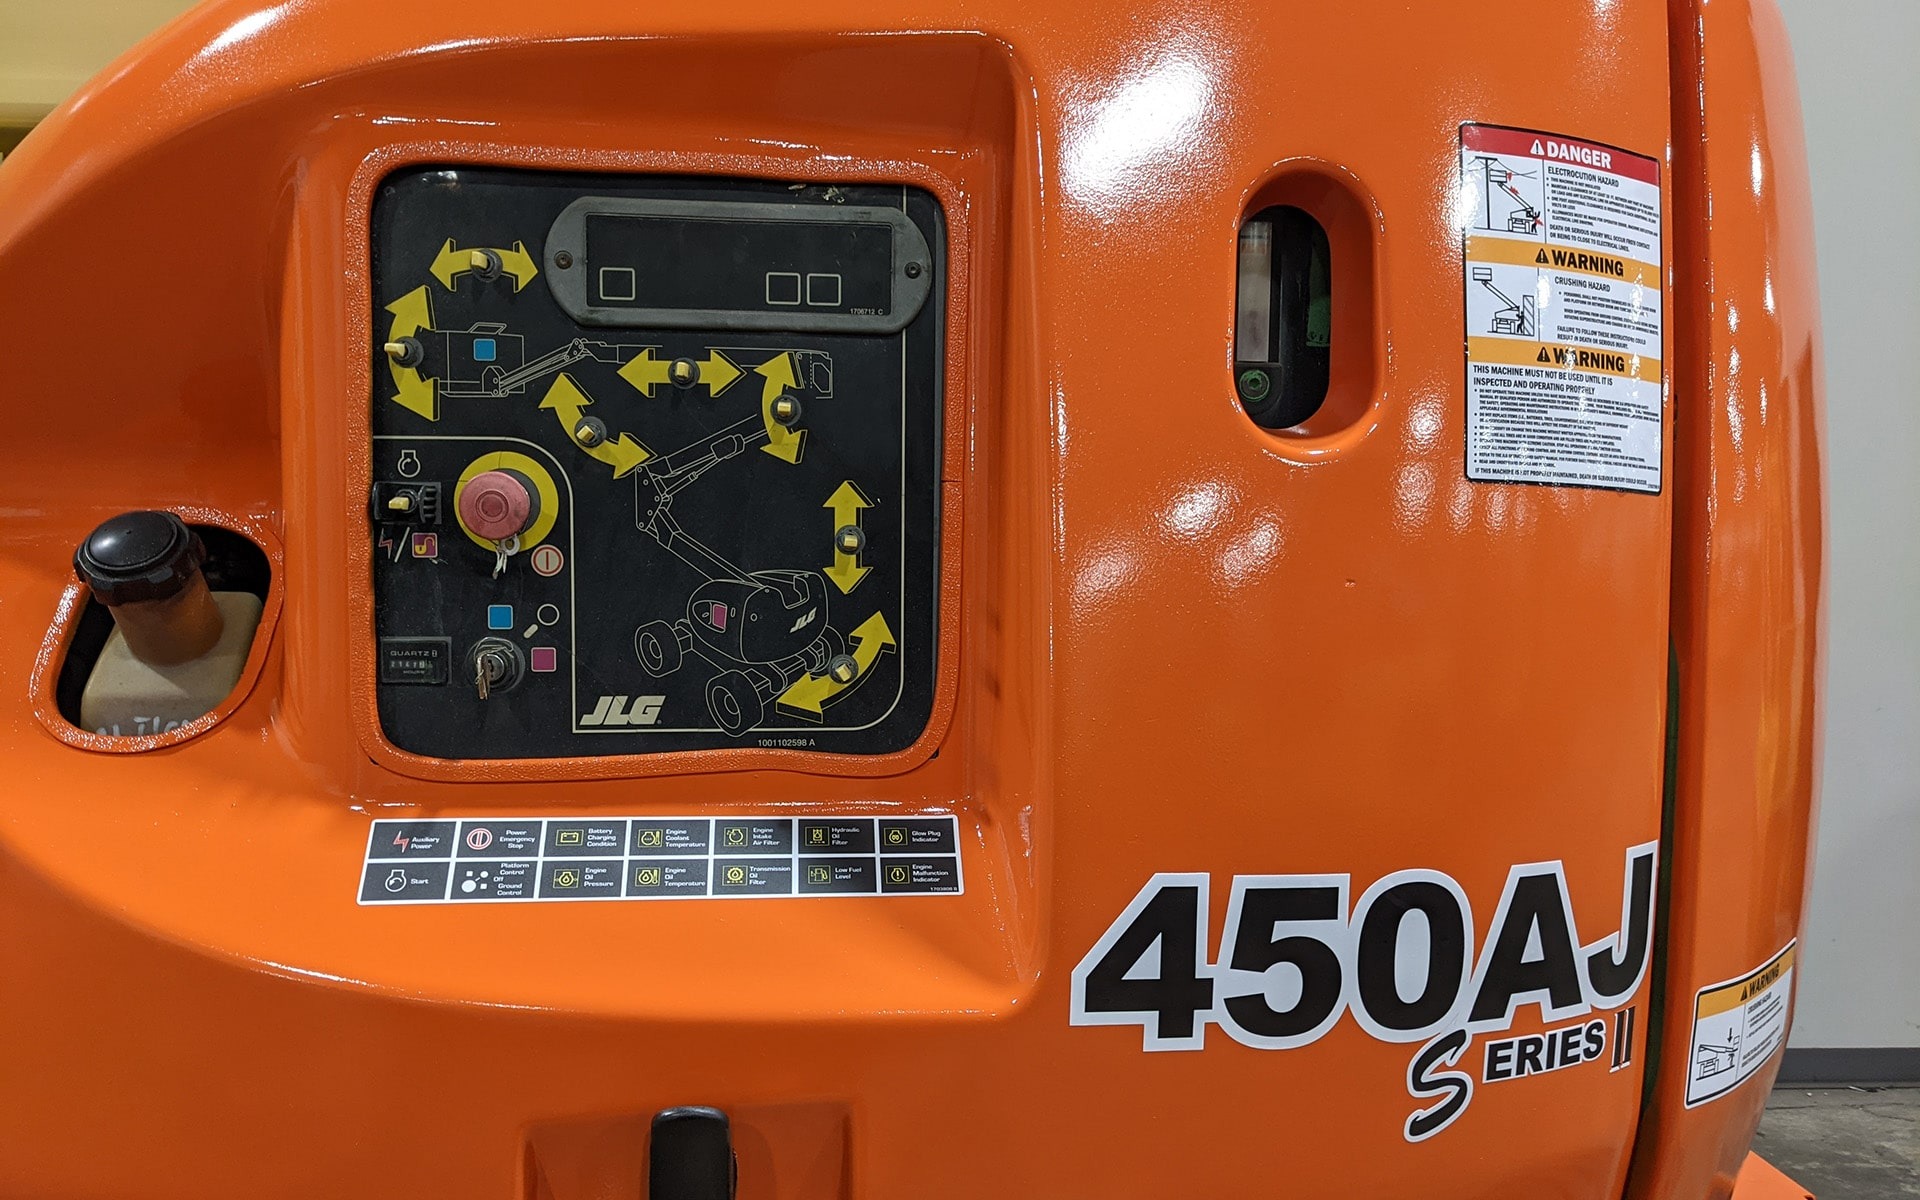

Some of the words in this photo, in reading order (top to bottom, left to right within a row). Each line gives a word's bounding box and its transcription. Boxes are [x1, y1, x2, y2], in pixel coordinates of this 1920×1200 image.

[1547, 141, 1611, 169] DANGER
[1548, 166, 1596, 182] ELECTROCUTION
[1598, 175, 1619, 188] HAZARD
[1577, 236, 1590, 244] CLOSE
[1597, 240, 1618, 249] ELECTRICAL
[1552, 250, 1624, 277] WARNING
[1555, 276, 1587, 288] CRUSHING
[1588, 281, 1610, 292] HAZARD
[1557, 325, 1575, 334] FAILURE
[1582, 328, 1597, 336] FOLLOW
[1580, 336, 1592, 344] DEATH
[1599, 338, 1615, 347] SERIOUS
[1473, 365, 1490, 374] THIS
[1491, 366, 1523, 376] MACHINE
[1524, 368, 1544, 378] MUST
[1545, 370, 1557, 379] NOT
[1558, 372, 1567, 380] BE
[1568, 372, 1584, 382] USED
[1585, 375, 1600, 384] UNTIL
[1601, 377, 1606, 385] IT
[1608, 378, 1613, 386] IS
[1474, 377, 1512, 387] INSPECTED
[1513, 380, 1528, 388] AND
[1529, 381, 1564, 392] OPERATING
[790, 606, 816, 634] JLG
[579, 695, 666, 726] JLG
[758, 739, 807, 747] 1001102598
[500, 836, 535, 844] Emergency
[1069, 840, 1658, 1052] 450AJ
[1749, 963, 1779, 997] WARNING
[1404, 1020, 1608, 1143] SERIES
[1609, 1005, 1636, 1074] II
